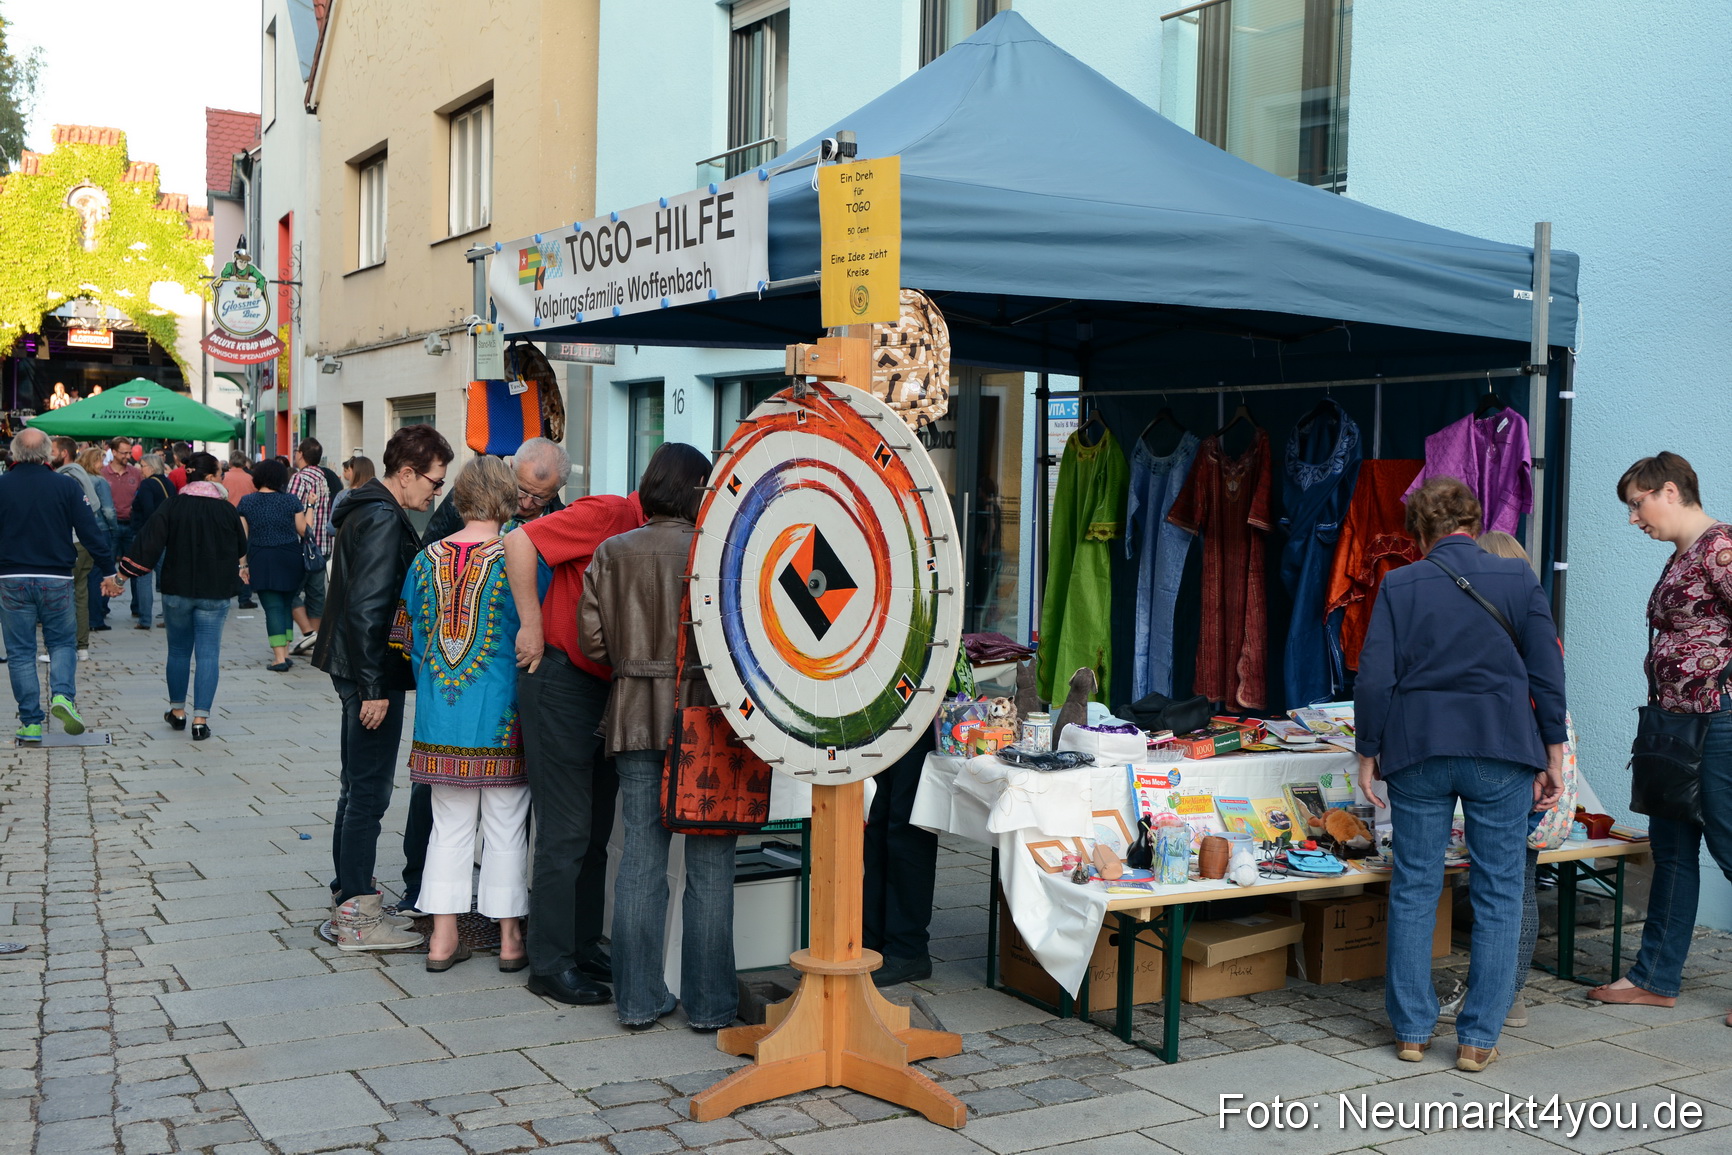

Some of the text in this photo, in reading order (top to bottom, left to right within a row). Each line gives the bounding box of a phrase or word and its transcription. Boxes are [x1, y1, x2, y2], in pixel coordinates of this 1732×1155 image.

[840, 170, 874, 184] Ein Dreh
[853, 187, 865, 196] für
[846, 201, 871, 213] TOGO
[847, 226, 870, 236] 50 Cent
[831, 249, 888, 265] Eine Idee zieht
[846, 268, 870, 278] Kreise
[534, 261, 713, 323] Kolpingsfamilie Woffenbach
[222, 299, 261, 317] Glossner
[242, 310, 261, 318] Bier
[209, 333, 277, 351] DELUXE KEBAP HAUS
[207, 345, 280, 360] TÜRKISCHE SPEZIALITÄTEN
[560, 344, 602, 358] ELITE
[672, 388, 685, 415] 16
[1195, 743, 1213, 755] 1000
[1140, 777, 1152, 785] Das
[1151, 778, 1167, 786] Meer
